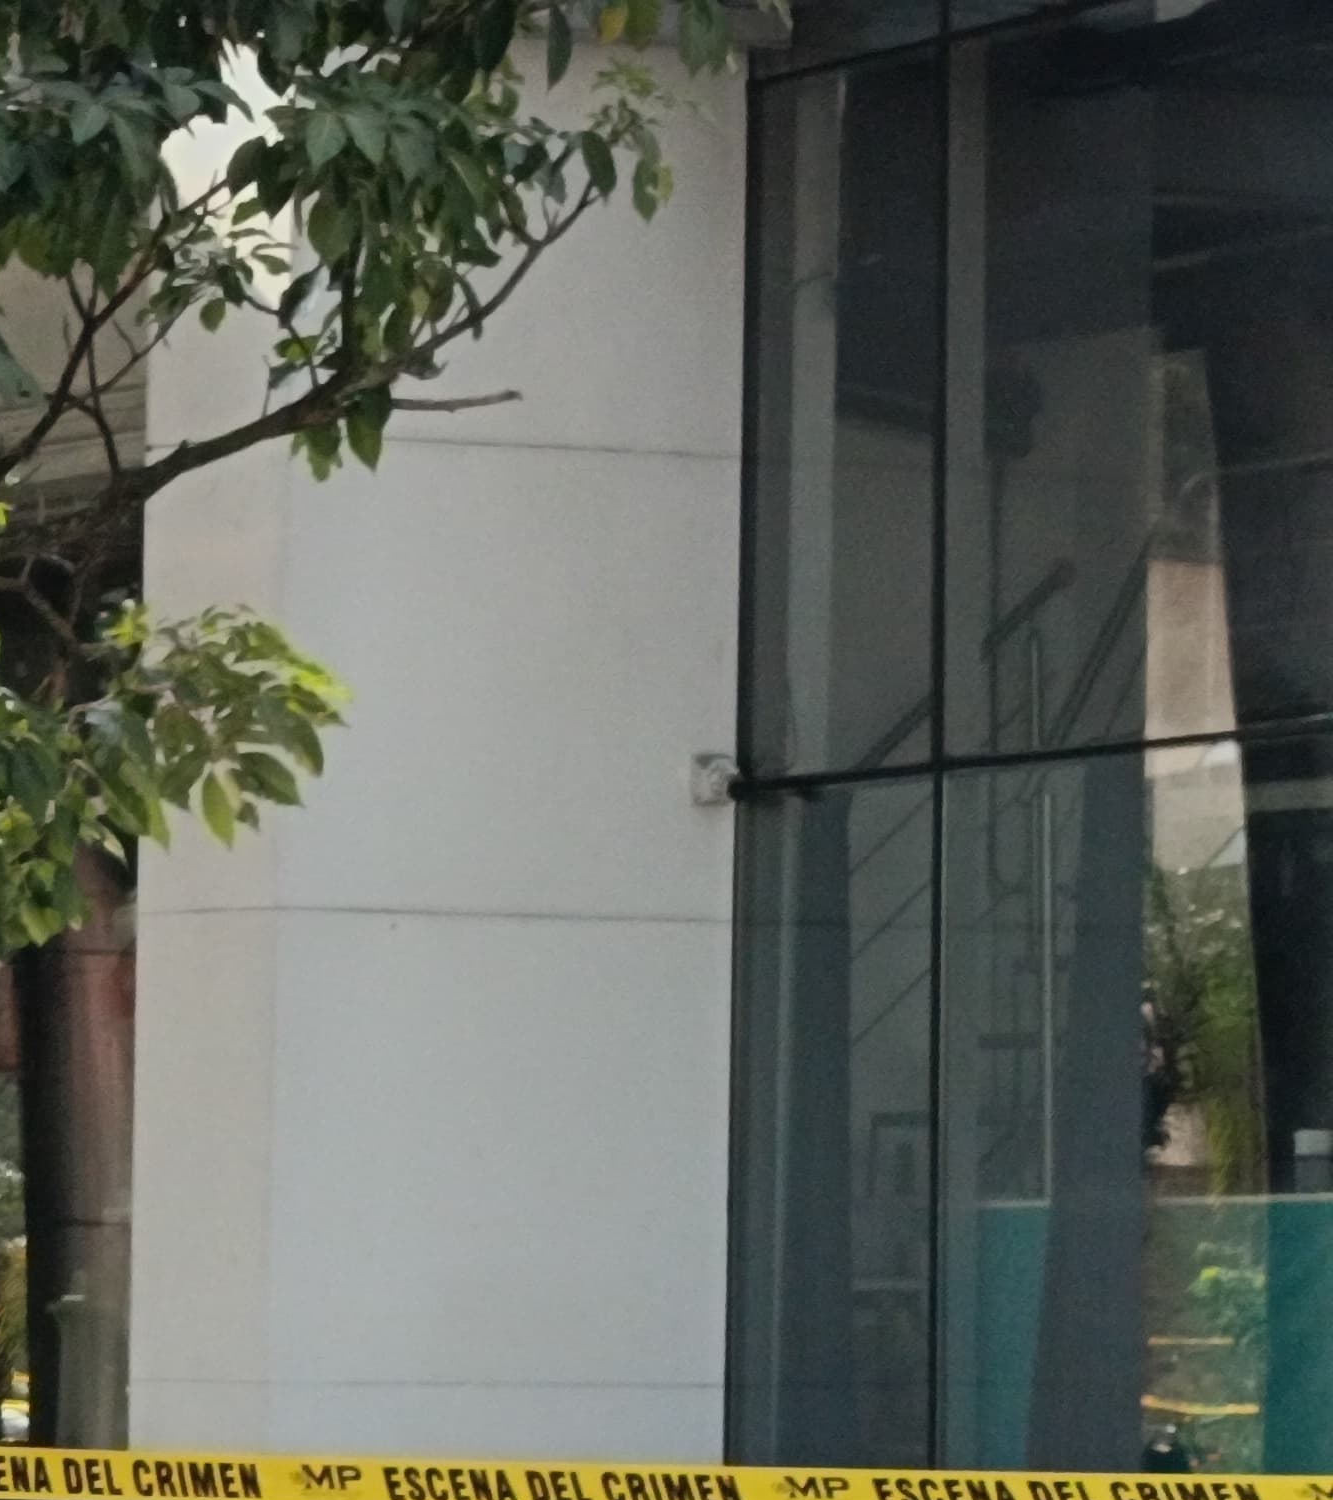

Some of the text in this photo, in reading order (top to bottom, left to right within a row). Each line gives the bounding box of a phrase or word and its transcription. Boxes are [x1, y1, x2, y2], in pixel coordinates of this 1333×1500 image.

[64, 1457, 122, 1496] DEL
[133, 1459, 261, 1500] CRIMEN
[300, 1463, 362, 1490] MP
[785, 1476, 852, 1500] MP
